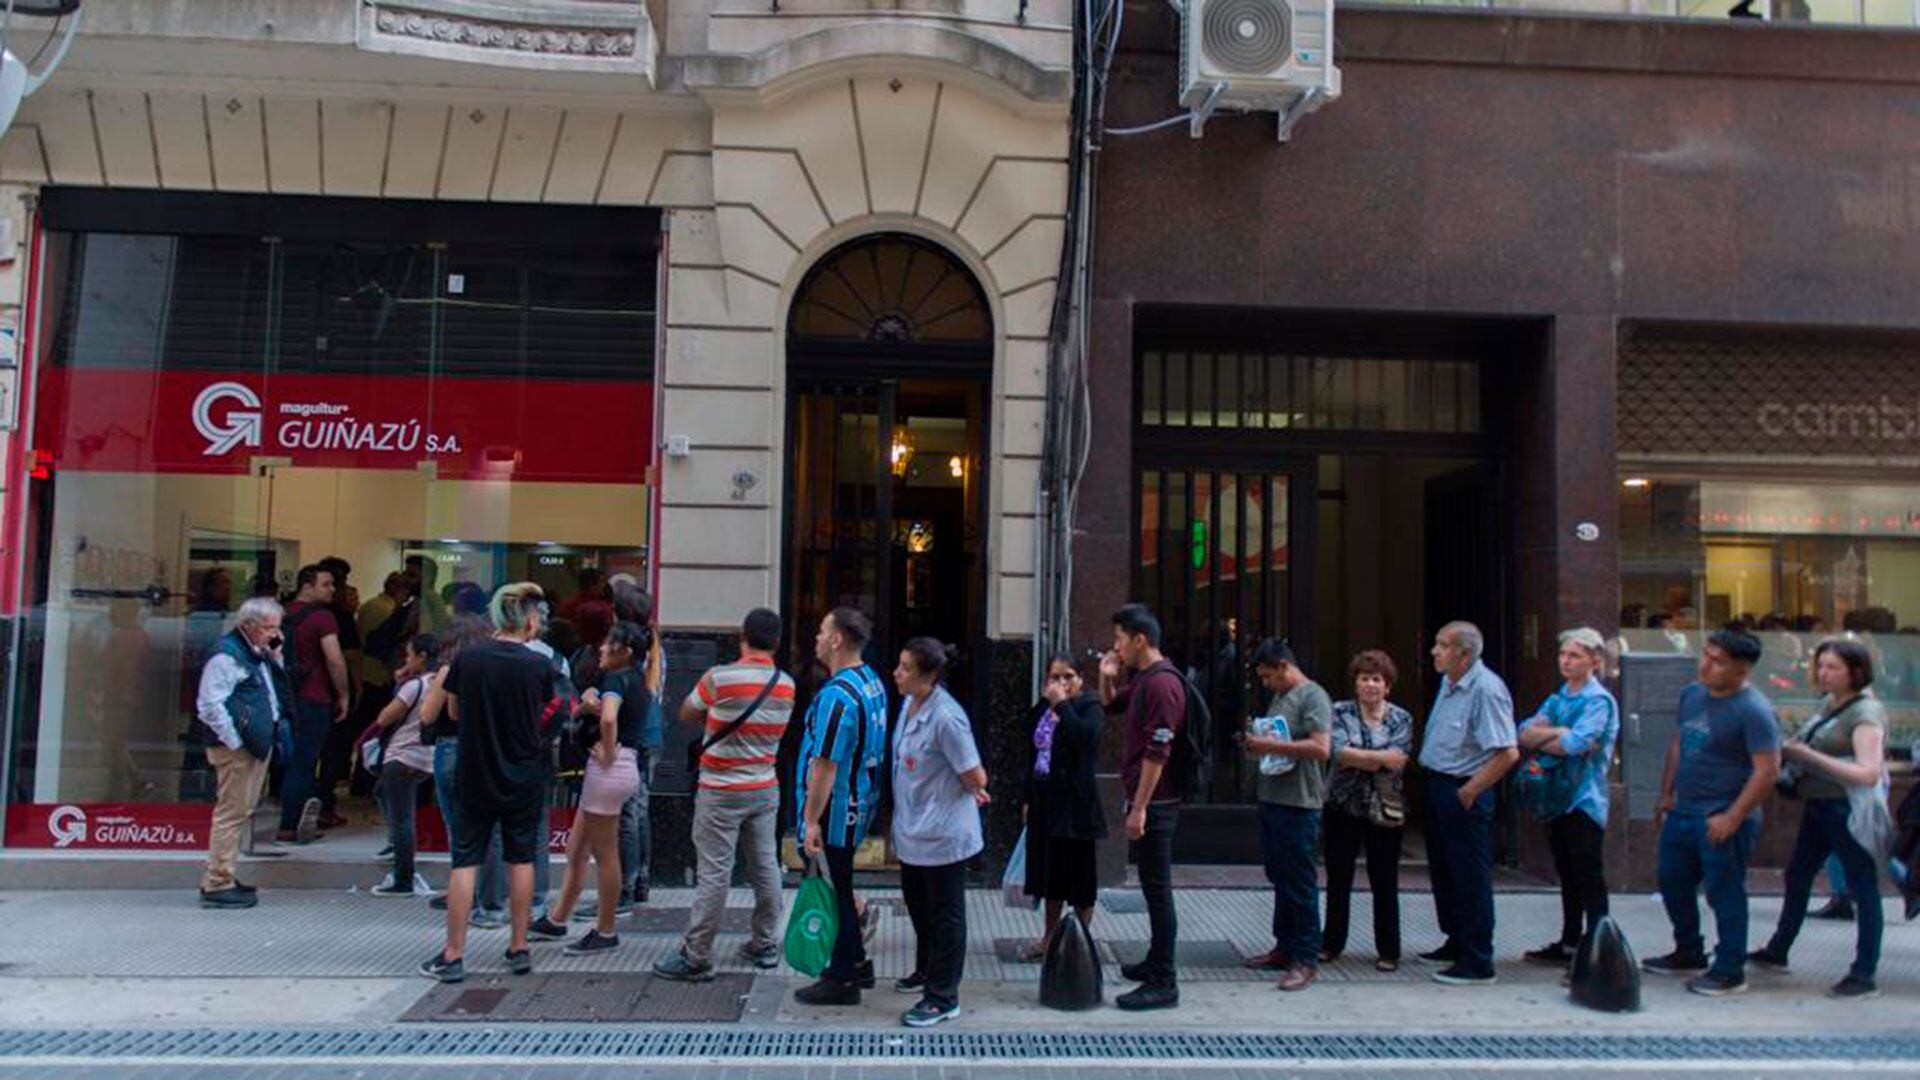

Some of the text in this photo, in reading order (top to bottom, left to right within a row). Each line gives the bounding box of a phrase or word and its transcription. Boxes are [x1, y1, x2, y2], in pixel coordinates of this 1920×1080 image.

[278, 416, 462, 453] GUIÑAZÚ S.A.
[95, 825, 174, 843] GUIÑAZÚ
